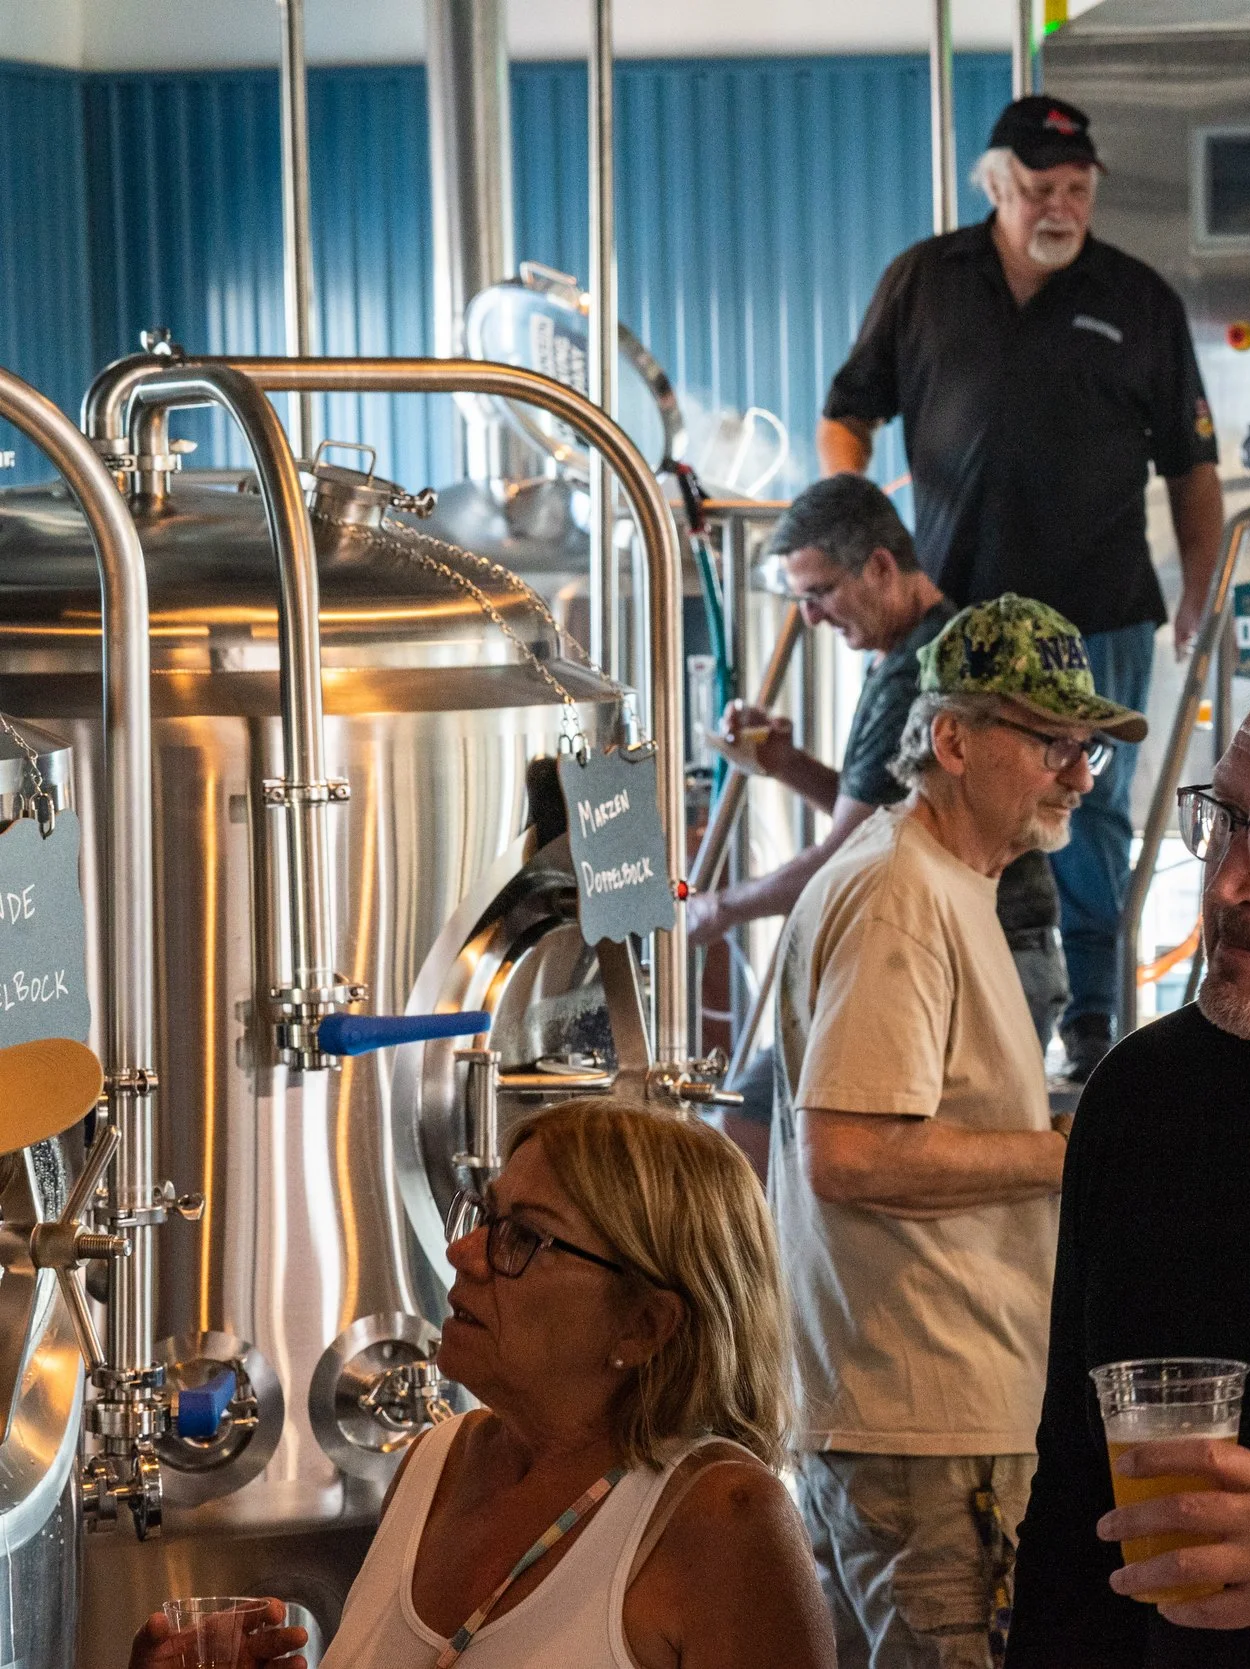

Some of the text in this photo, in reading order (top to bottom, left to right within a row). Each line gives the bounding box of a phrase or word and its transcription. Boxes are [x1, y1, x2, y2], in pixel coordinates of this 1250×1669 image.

[1035, 636, 1088, 669] NA
[581, 857, 654, 898] DOPPELBOCK
[0, 883, 35, 925] DE
